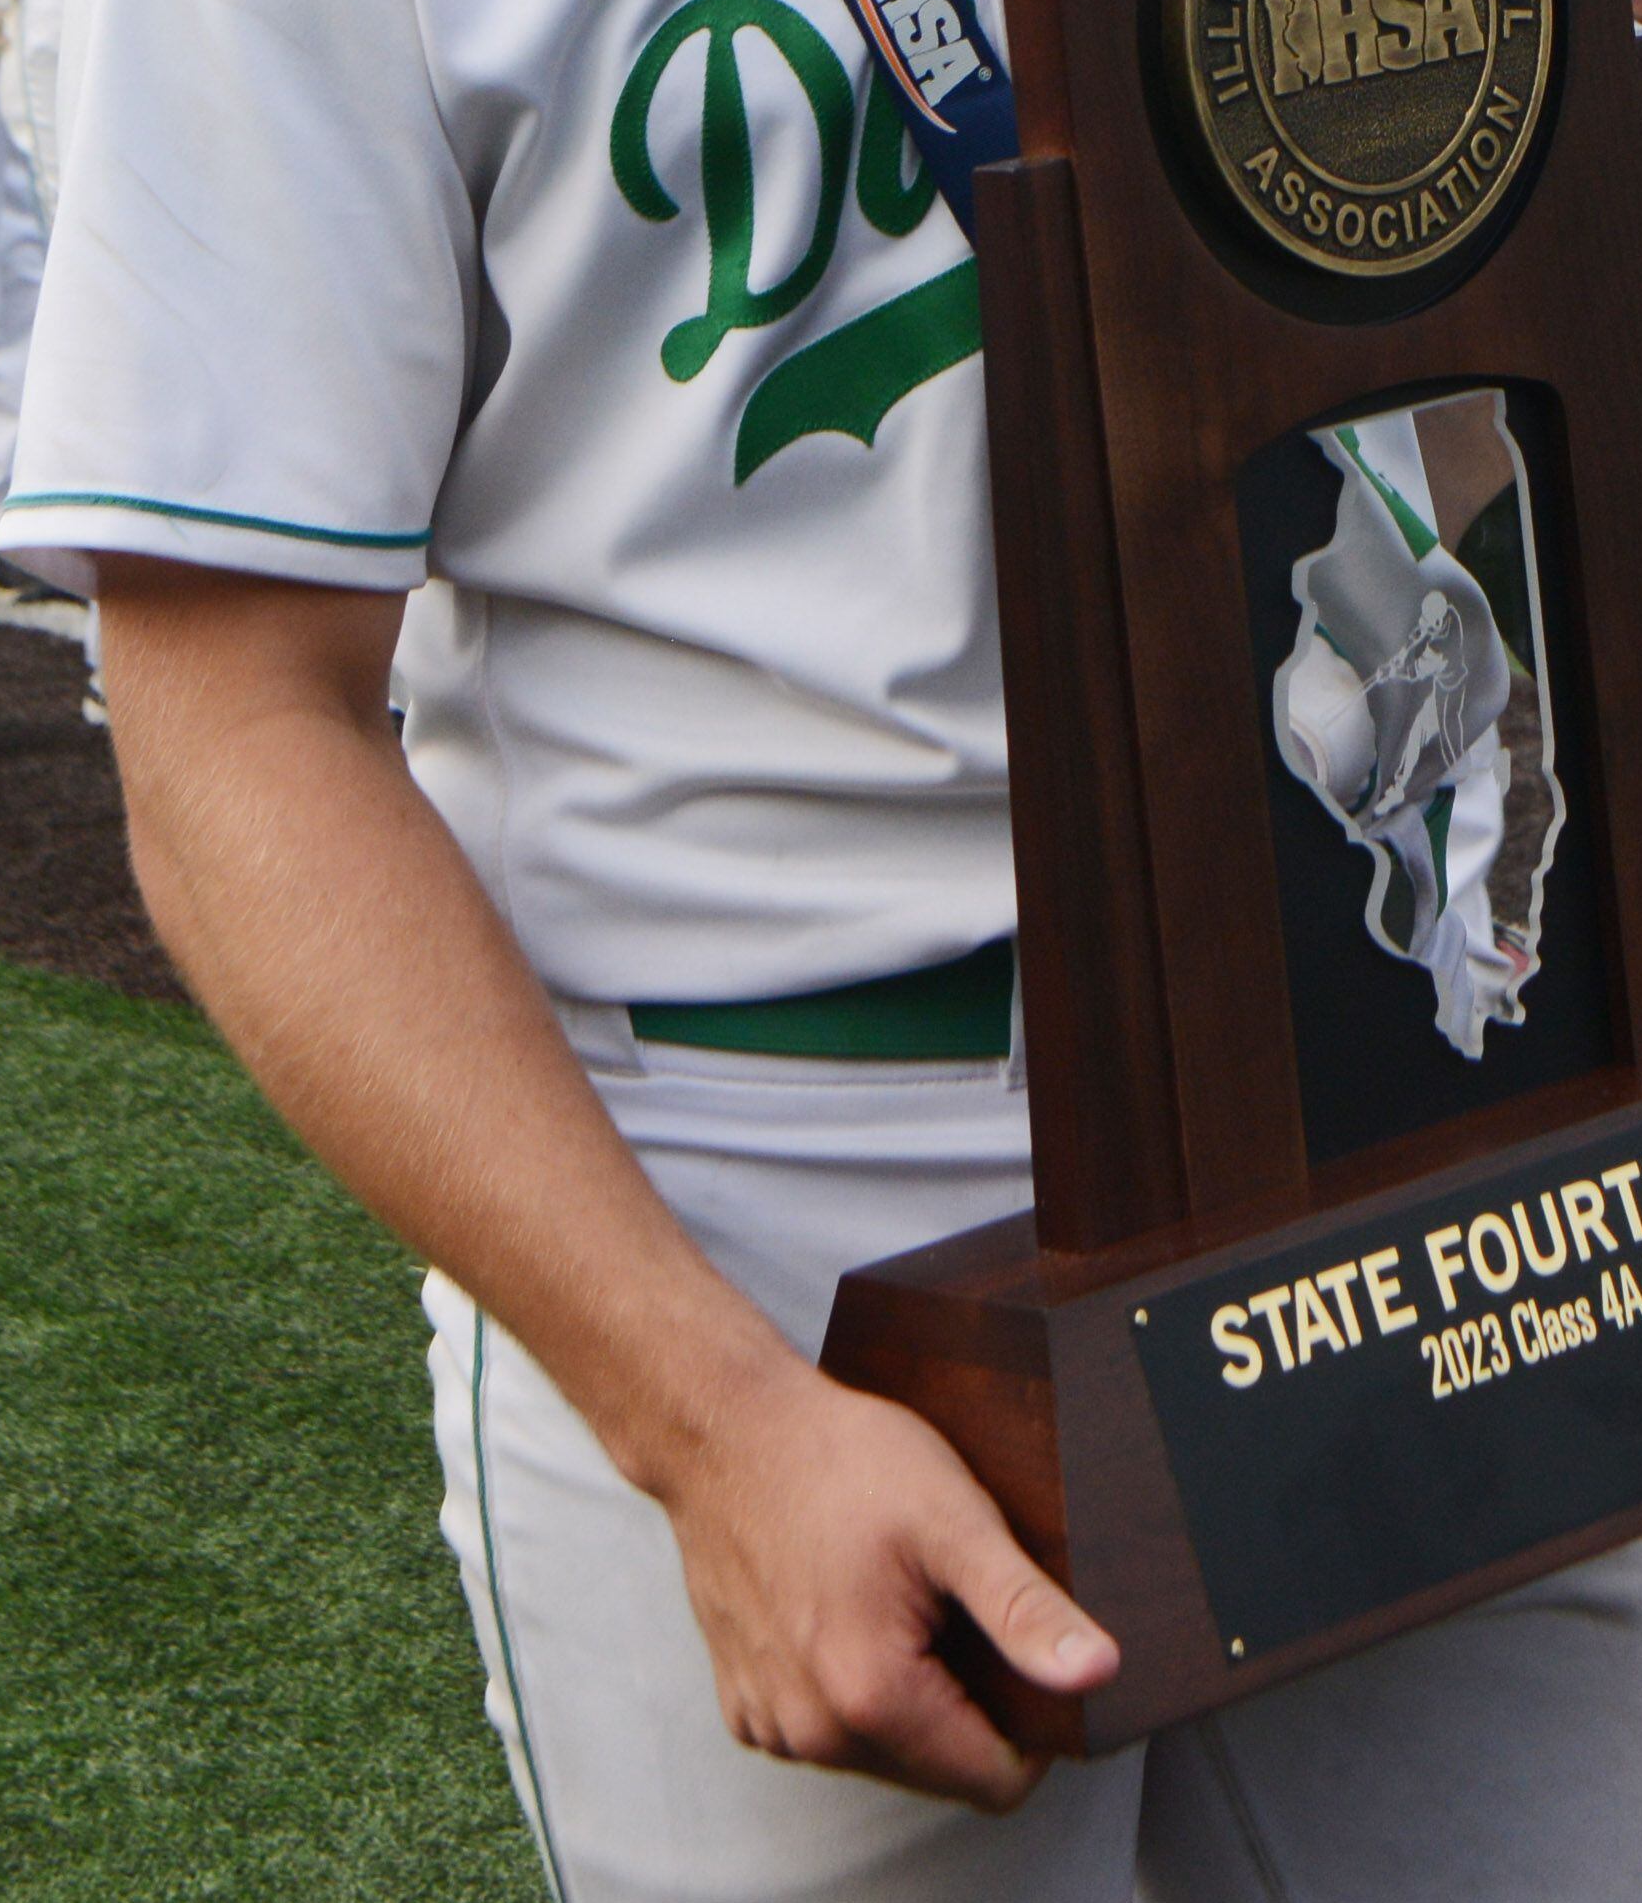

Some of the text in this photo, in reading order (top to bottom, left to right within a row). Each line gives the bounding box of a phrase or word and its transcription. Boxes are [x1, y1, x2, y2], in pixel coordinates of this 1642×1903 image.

[1244, 86, 1523, 250] ASSOCIATION
[1209, 1247, 1418, 1390] STATE
[1420, 1324, 1510, 1400] 2023
[1509, 1292, 1598, 1367] Class
